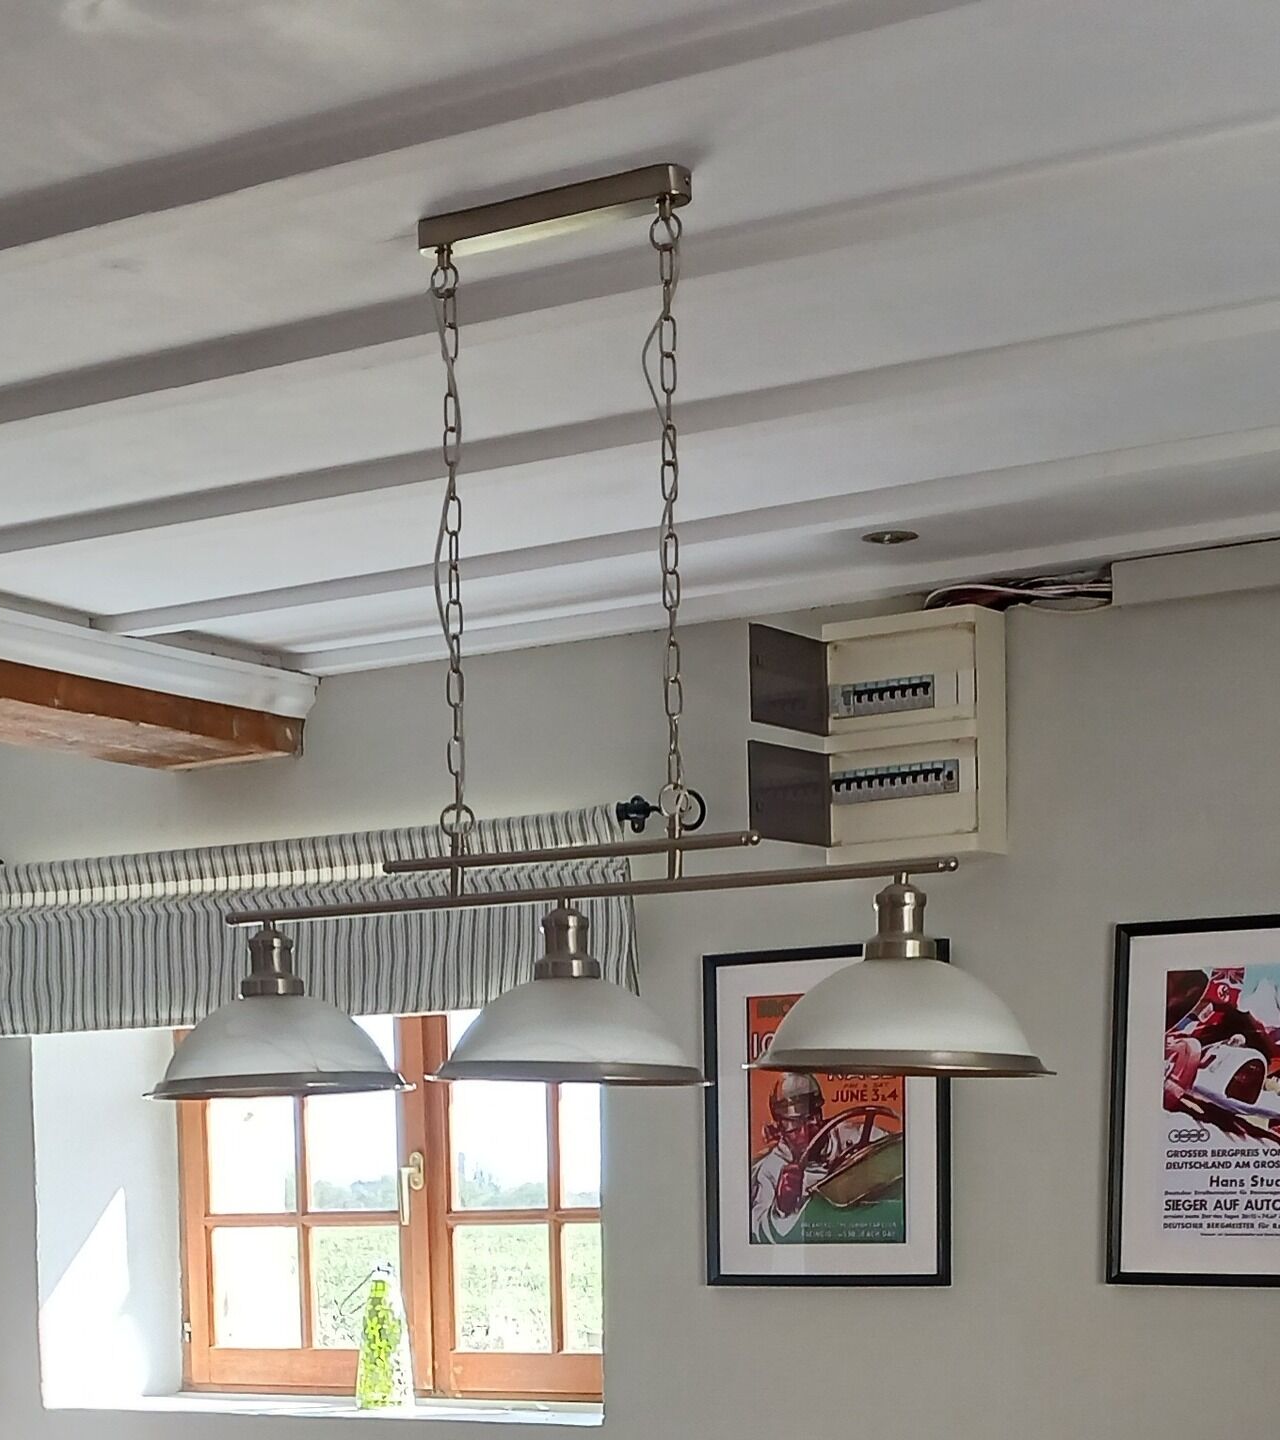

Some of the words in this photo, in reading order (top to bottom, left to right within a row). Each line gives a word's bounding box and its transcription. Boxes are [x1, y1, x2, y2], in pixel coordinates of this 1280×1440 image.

[832, 1089, 868, 1102] JUNE
[1166, 1149, 1208, 1158] GROSSER
[1211, 1148, 1260, 1157] BERGPREIS
[1166, 1160, 1232, 1170] DEUTSCHLAND
[1234, 1160, 1251, 1169] AM
[1209, 1175, 1245, 1188] Hans
[1164, 1199, 1208, 1211] SIEGER
[1213, 1199, 1240, 1211] AUF
